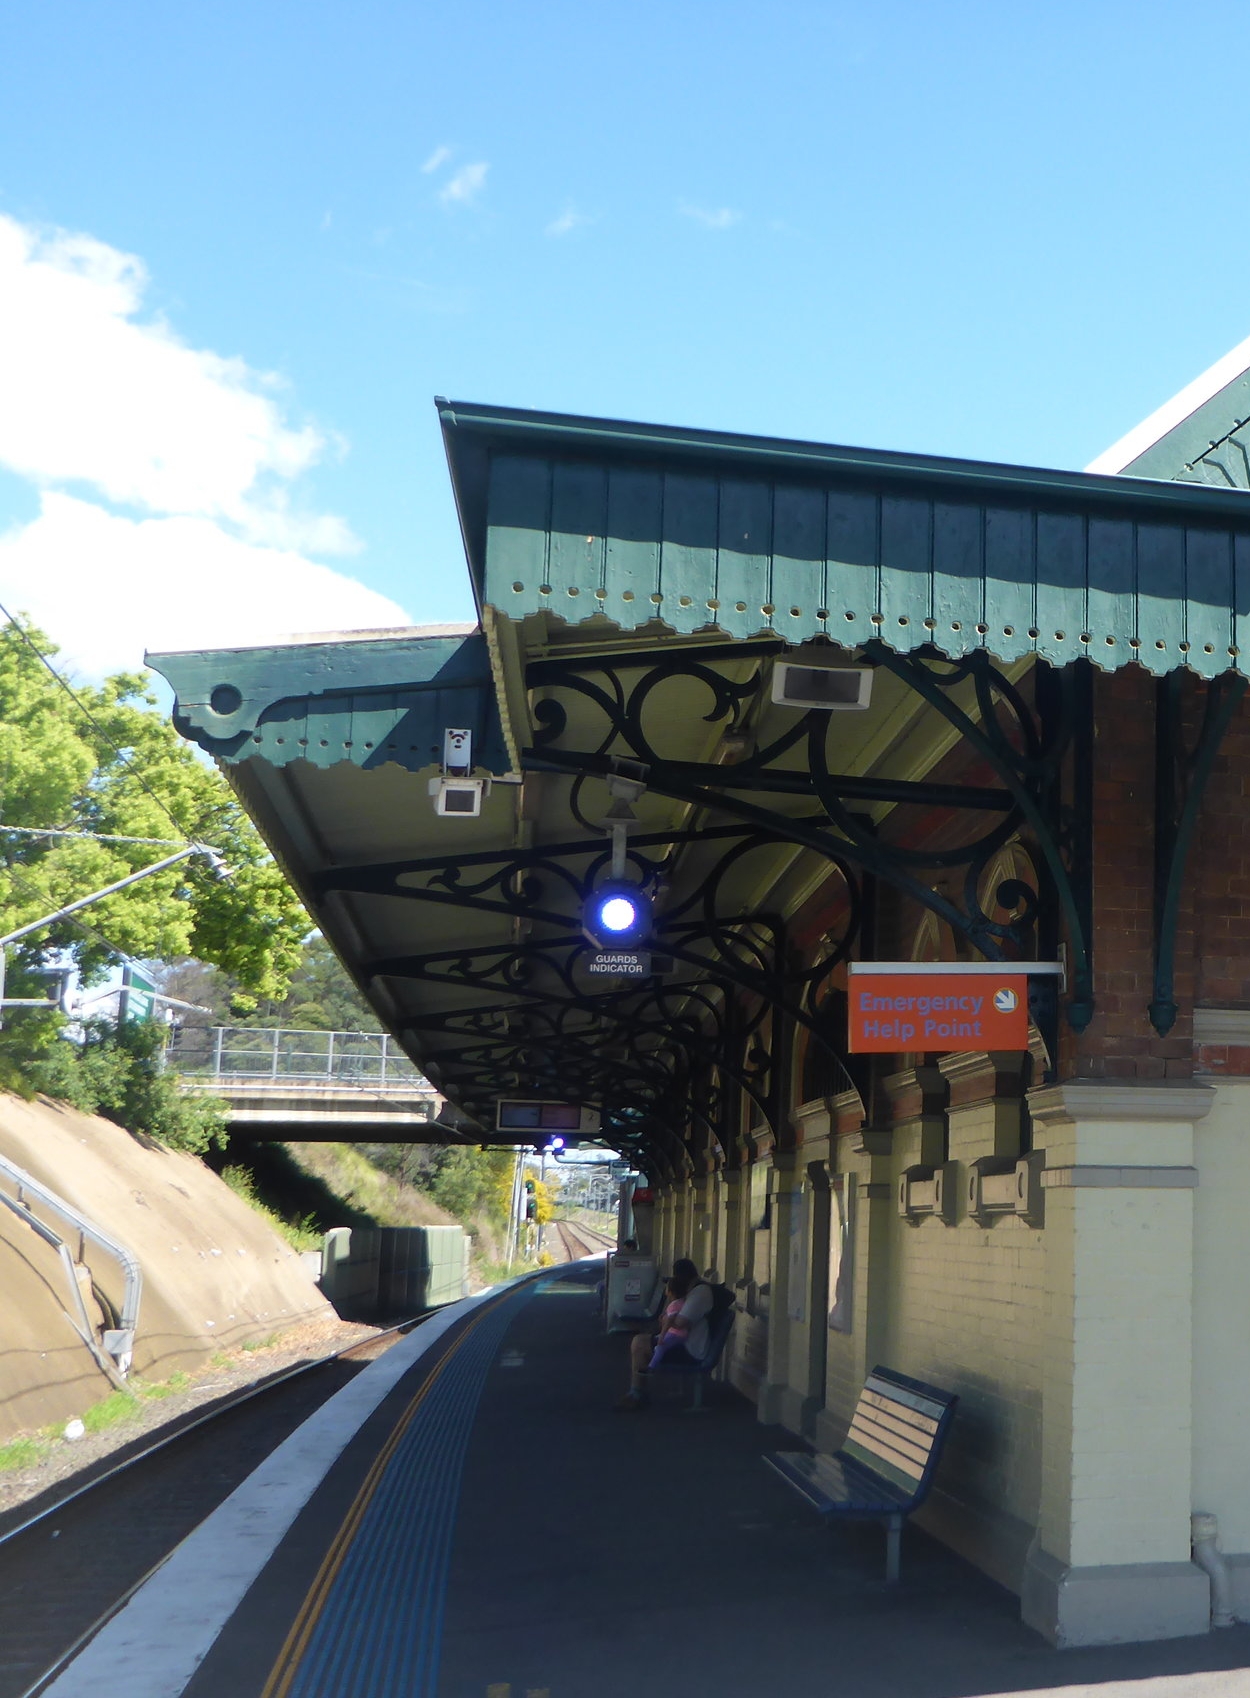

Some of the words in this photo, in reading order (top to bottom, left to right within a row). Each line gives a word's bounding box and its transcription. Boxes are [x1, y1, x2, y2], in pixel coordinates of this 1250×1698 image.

[595, 954, 638, 964] GUARDS
[590, 964, 643, 973] INDICATOR
[859, 992, 984, 1016] Emergency
[863, 1019, 915, 1042] Help
[924, 1019, 982, 1037] Point
